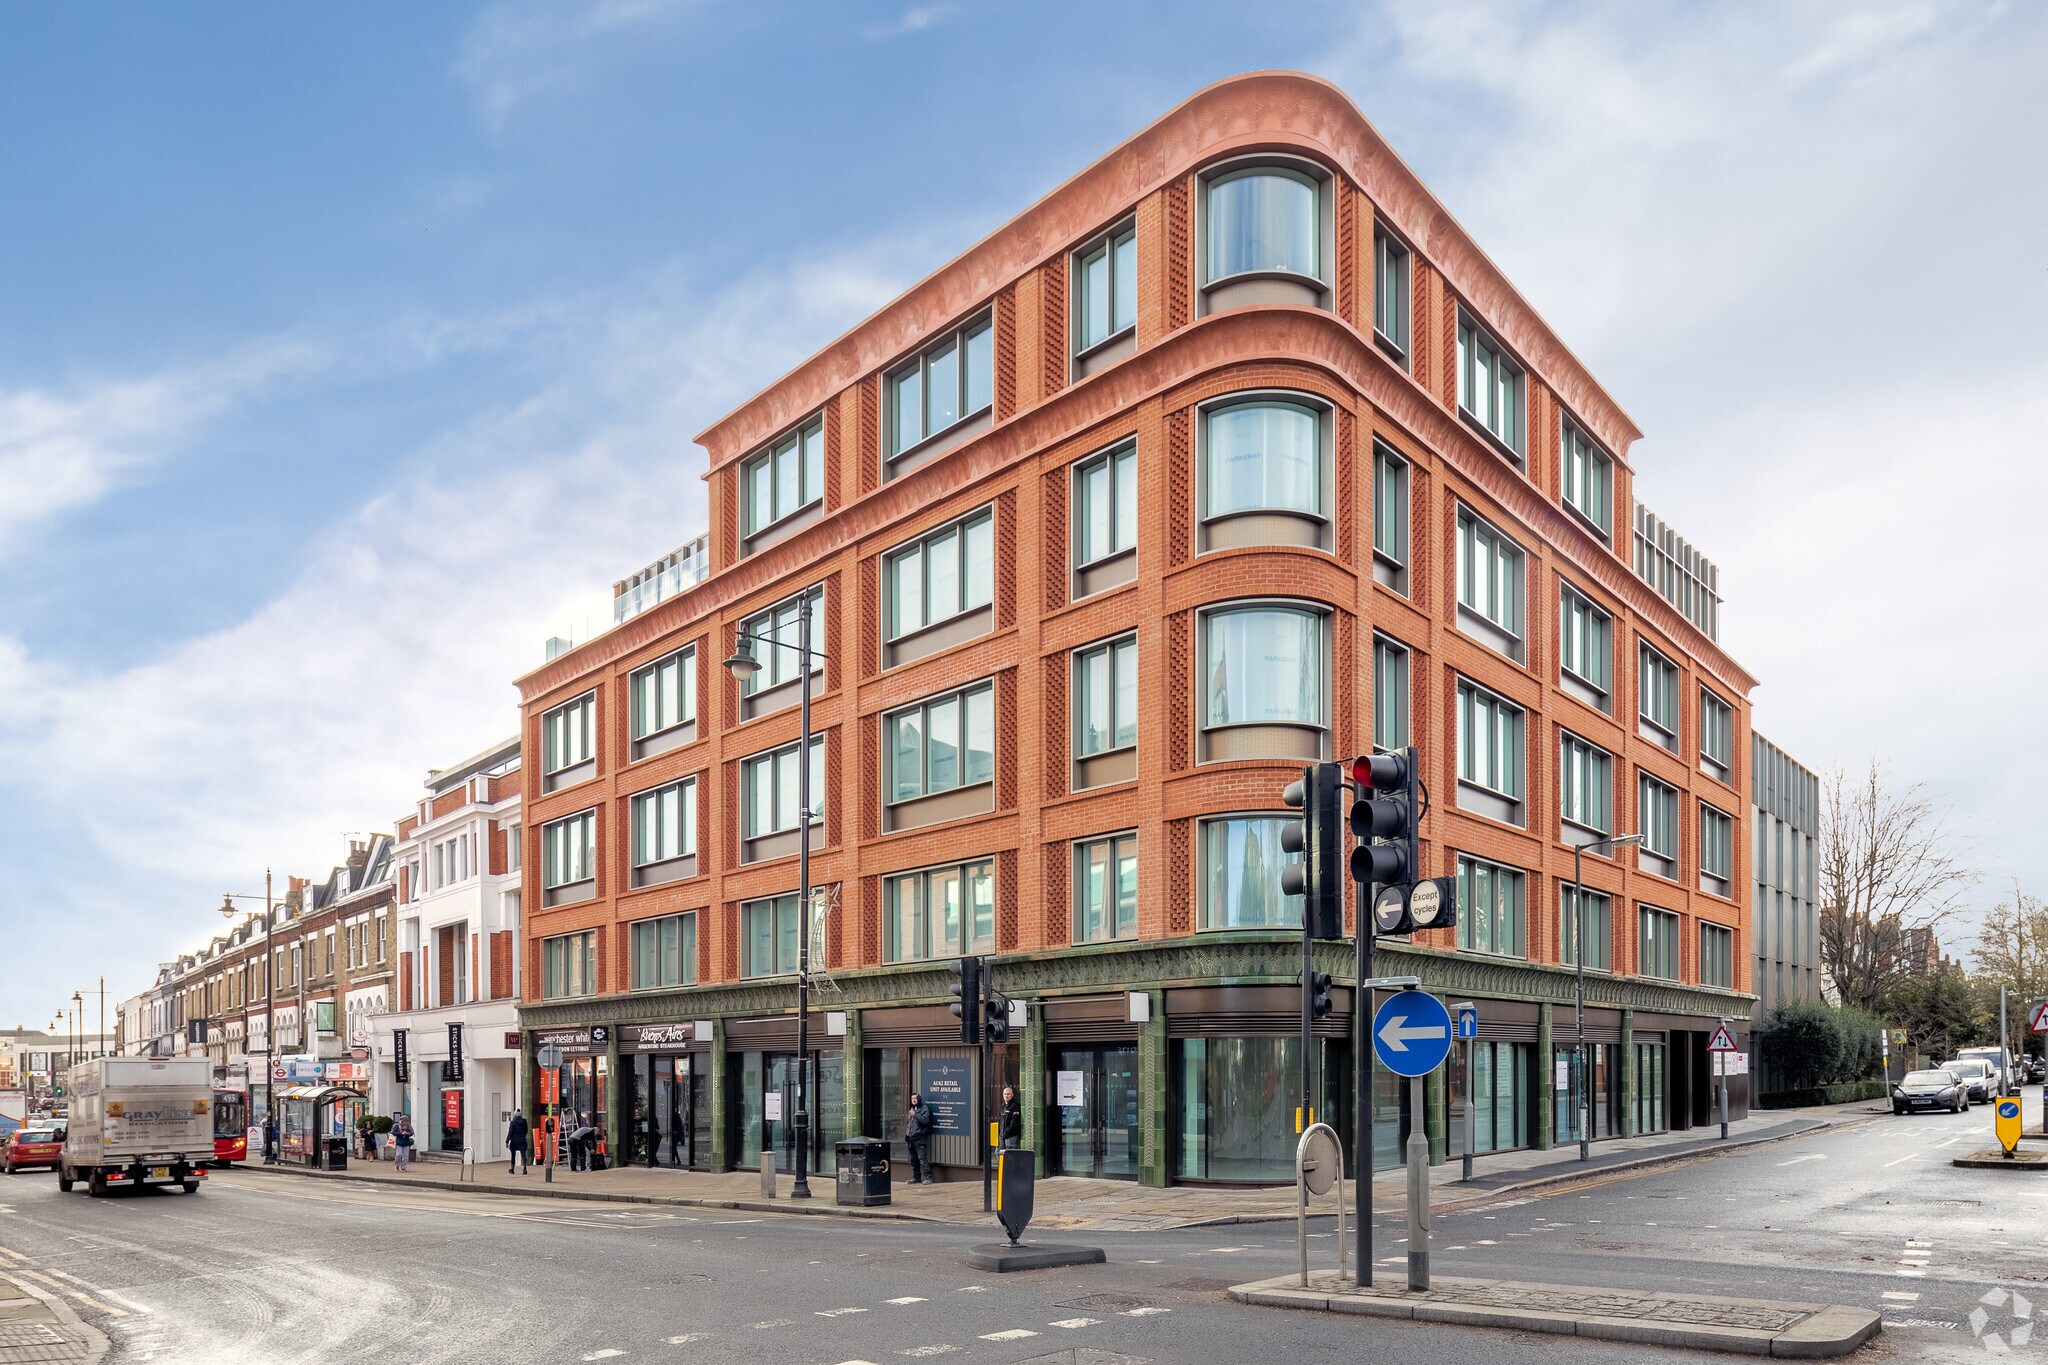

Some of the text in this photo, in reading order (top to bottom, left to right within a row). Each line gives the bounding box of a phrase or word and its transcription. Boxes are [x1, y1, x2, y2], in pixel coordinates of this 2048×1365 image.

[1413, 891, 1438, 902] Except
[1413, 904, 1437, 915] cycles
[575, 1032, 590, 1043] whit
[637, 1026, 686, 1043] Buenos Aires
